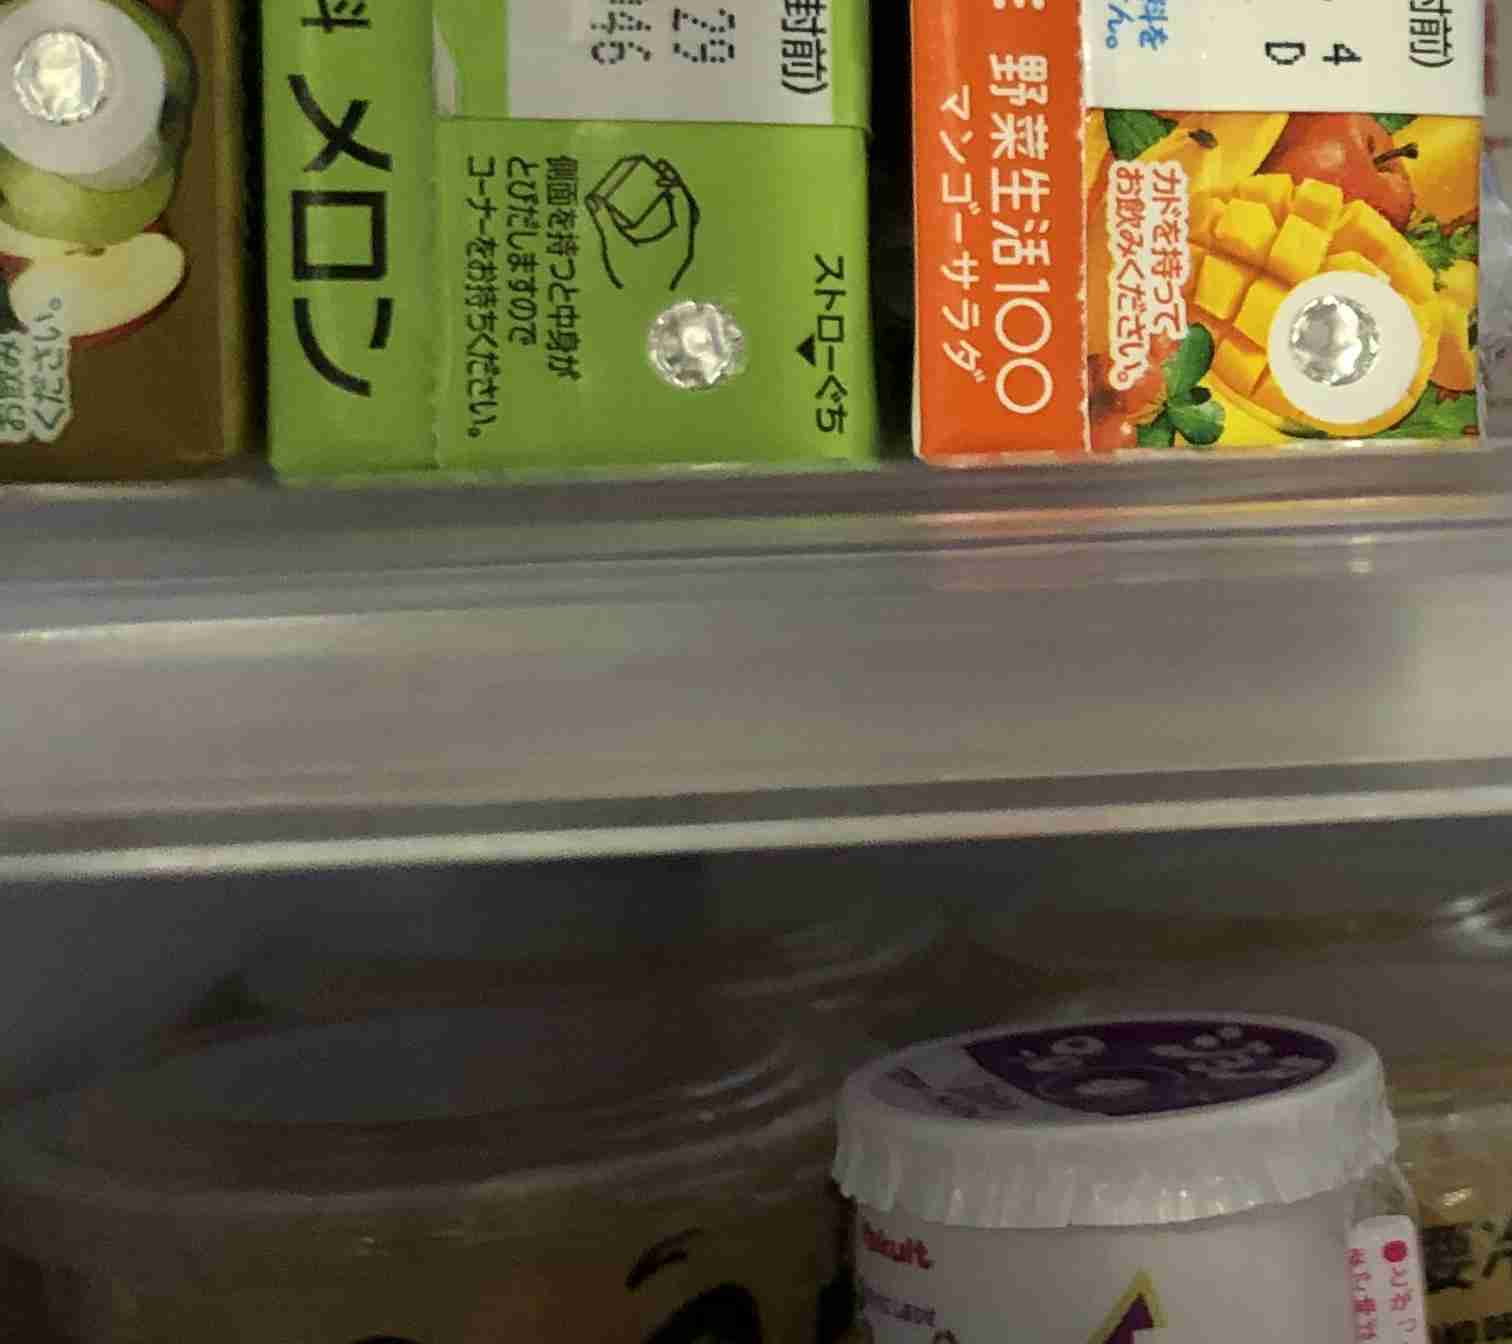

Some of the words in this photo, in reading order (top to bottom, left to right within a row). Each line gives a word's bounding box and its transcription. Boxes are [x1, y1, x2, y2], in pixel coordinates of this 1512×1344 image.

[673, 8, 737, 65] 29
[1264, 41, 1306, 68] D
[288, 74, 395, 397] メロン
[464, 156, 498, 440] コーナーをお持ちください。
[506, 157, 539, 346] とびだしますので
[545, 156, 580, 380] 側面を持つと中身が
[814, 254, 846, 433] ストローぐち
[938, 84, 983, 384] マンゴーサラダ
[988, 53, 1052, 415] 野菜生活100
[1114, 167, 1148, 388] お飲みください。
[1149, 167, 1184, 334] カドを持って
